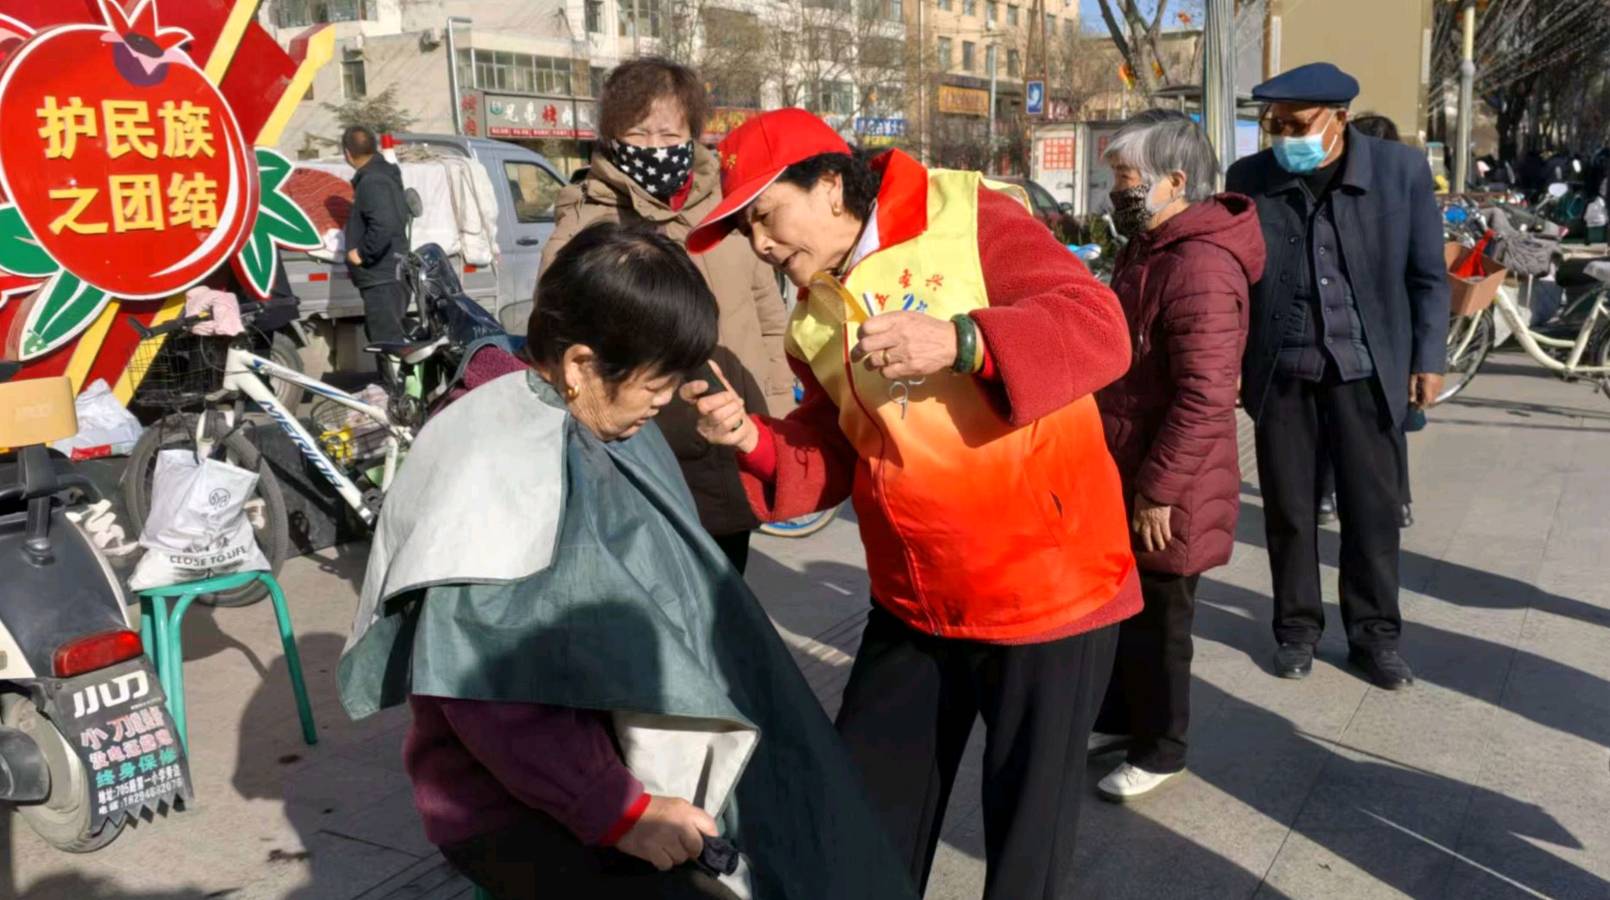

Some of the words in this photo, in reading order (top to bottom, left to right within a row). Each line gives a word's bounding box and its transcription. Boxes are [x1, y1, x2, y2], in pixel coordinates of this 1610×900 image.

[36, 96, 215, 160] 护民族
[48, 172, 219, 236] 之团结
[169, 554, 207, 567] CLOSE
[211, 554, 226, 564] TO
